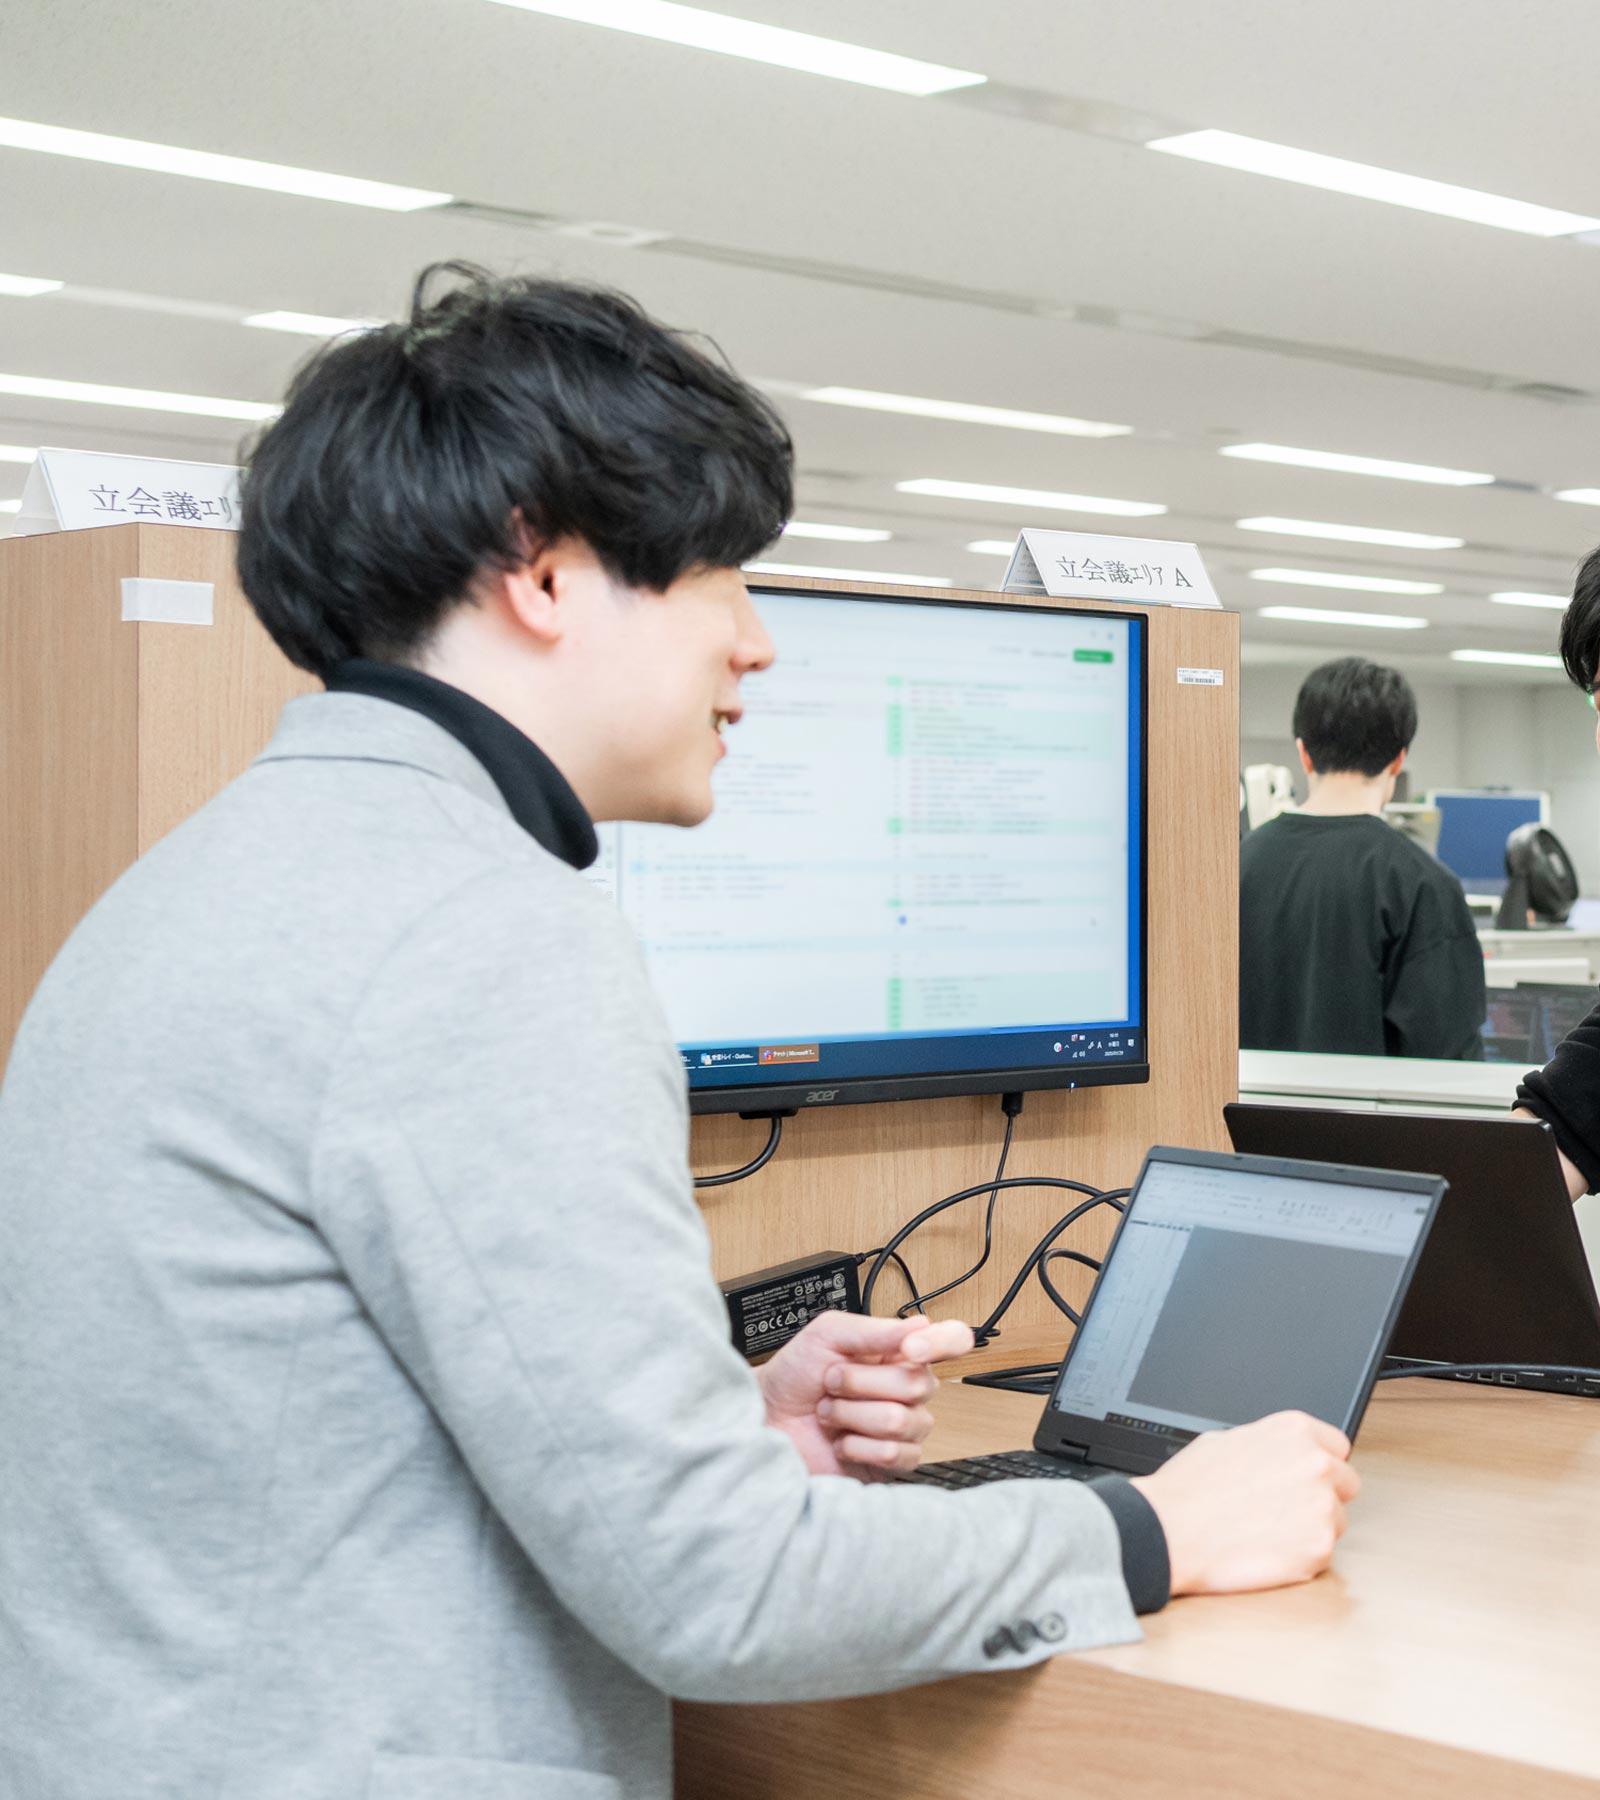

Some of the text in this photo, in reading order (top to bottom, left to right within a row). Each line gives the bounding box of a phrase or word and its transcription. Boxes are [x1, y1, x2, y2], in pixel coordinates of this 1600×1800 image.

[88, 484, 243, 524] 立会議エリ
[1055, 555, 1164, 586] 立会議エリア
[1175, 567, 1193, 588] A
[806, 1089, 840, 1103] acer
